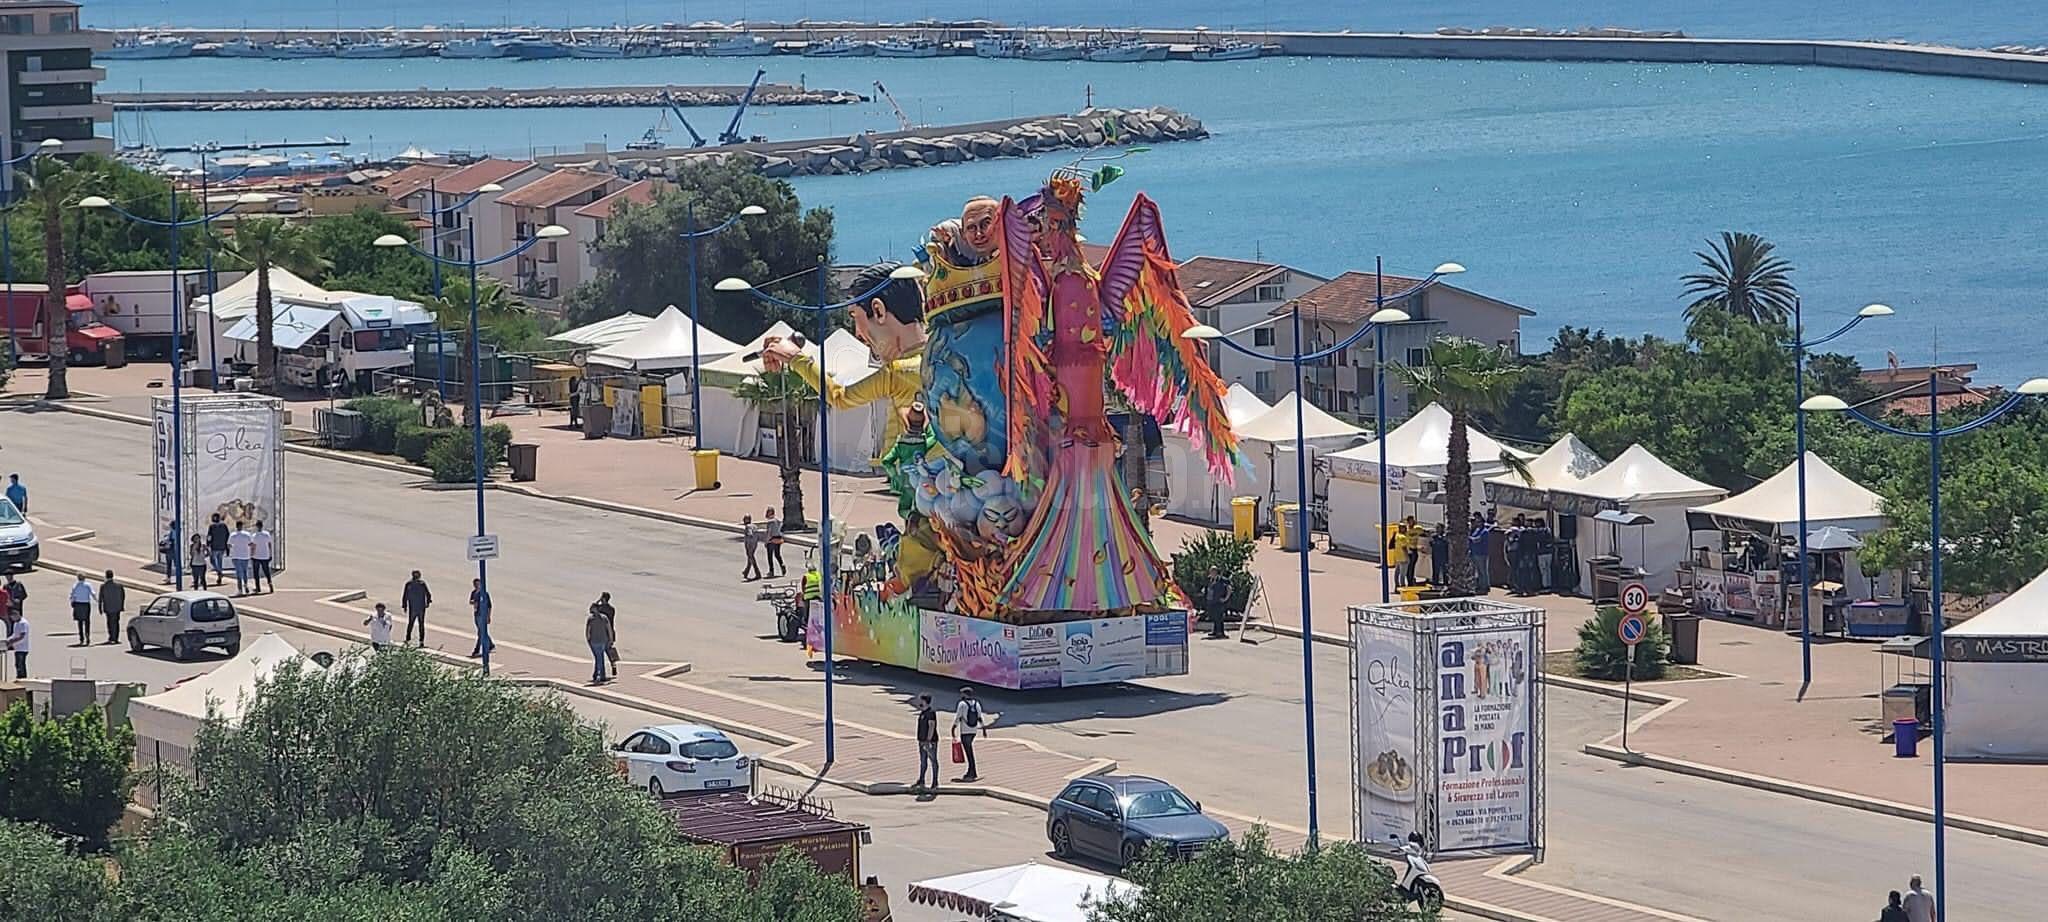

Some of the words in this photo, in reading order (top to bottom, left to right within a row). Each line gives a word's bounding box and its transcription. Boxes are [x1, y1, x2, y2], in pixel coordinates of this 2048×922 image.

[1627, 592, 1642, 606] 30
[921, 635, 935, 662] The
[937, 644, 958, 664] Show
[960, 639, 979, 660] Must
[981, 637, 994, 657] Go
[1481, 703, 1512, 712] FORMAZIONE
[1479, 713, 1500, 721] PORTATA
[1480, 722, 1495, 730] MANO
[1442, 778, 1480, 791] Formazione
[1481, 775, 1525, 787] Professionale
[1454, 792, 1483, 802] Sicurezza
[1486, 789, 1495, 800] sul
[1497, 789, 1519, 799] Lavoro
